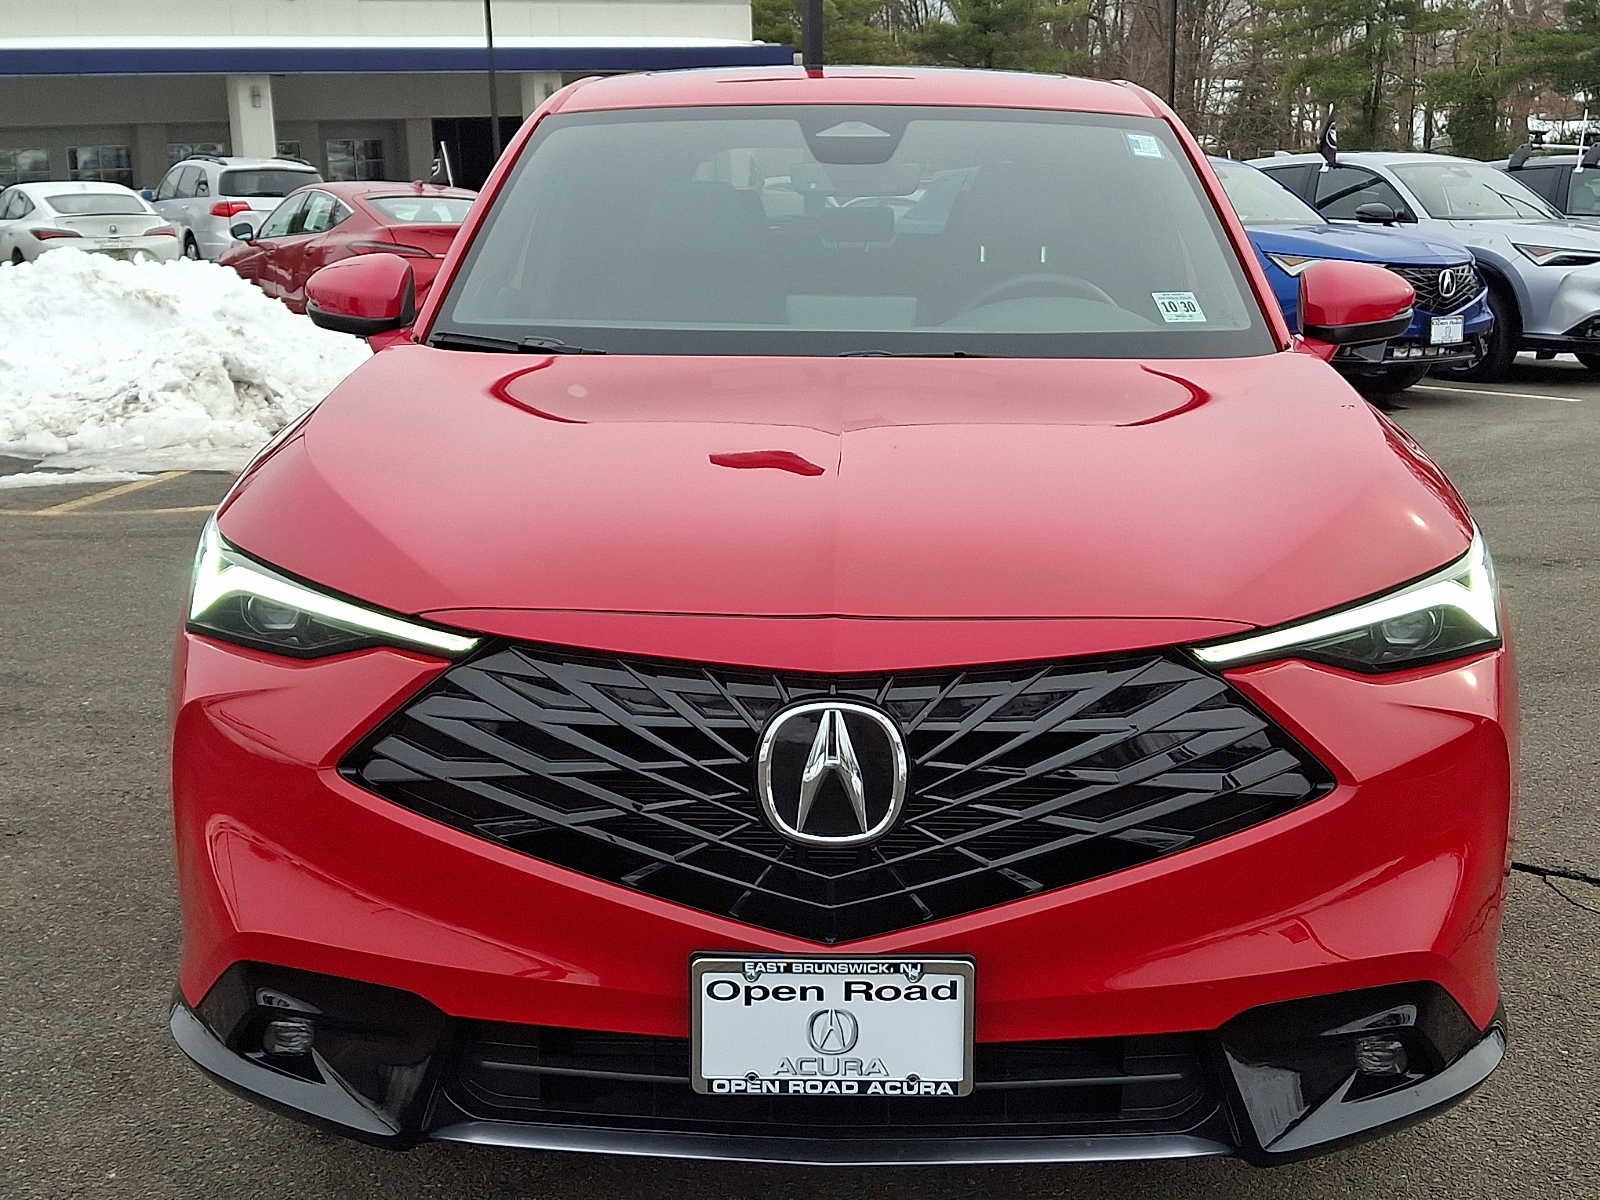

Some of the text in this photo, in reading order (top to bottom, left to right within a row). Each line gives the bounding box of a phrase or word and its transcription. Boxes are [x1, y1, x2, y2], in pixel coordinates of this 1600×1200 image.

[1160, 301, 1197, 312] 10 30
[744, 962, 787, 973] EAST
[900, 963, 921, 974] NJ
[706, 980, 958, 1006] Open Road
[774, 1057, 890, 1076] ACURA
[712, 1080, 954, 1096] OPEN ROAD ACURA
